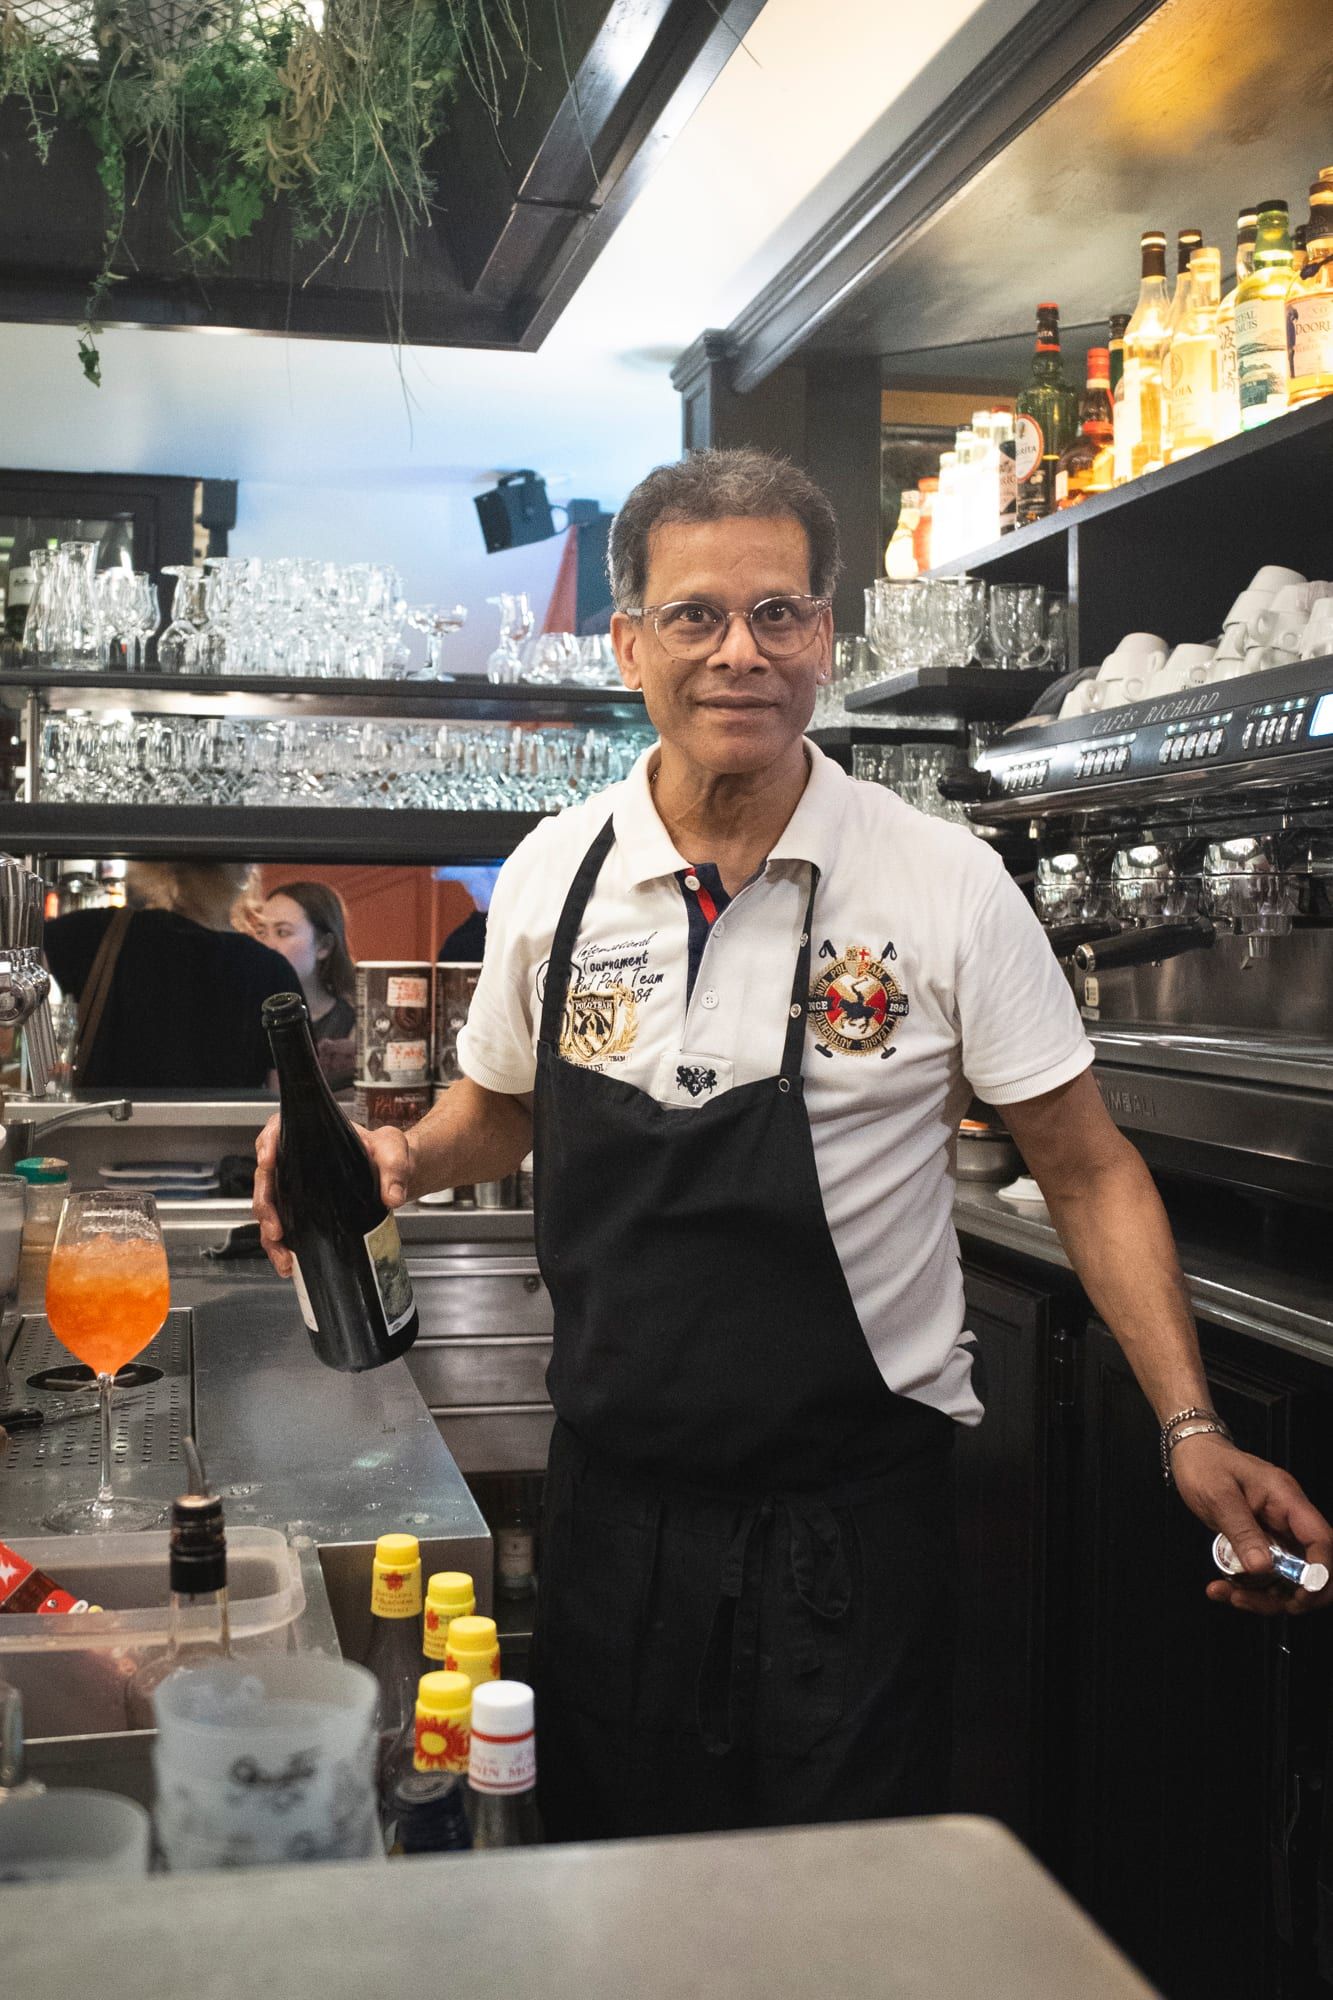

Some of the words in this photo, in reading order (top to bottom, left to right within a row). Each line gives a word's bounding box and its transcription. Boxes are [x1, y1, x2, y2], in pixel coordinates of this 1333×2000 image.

[1143, 692, 1220, 724] RICHARD
[581, 949, 649, 975] Tournament
[631, 966, 665, 988] Team
[808, 1001, 829, 1011] NCE
